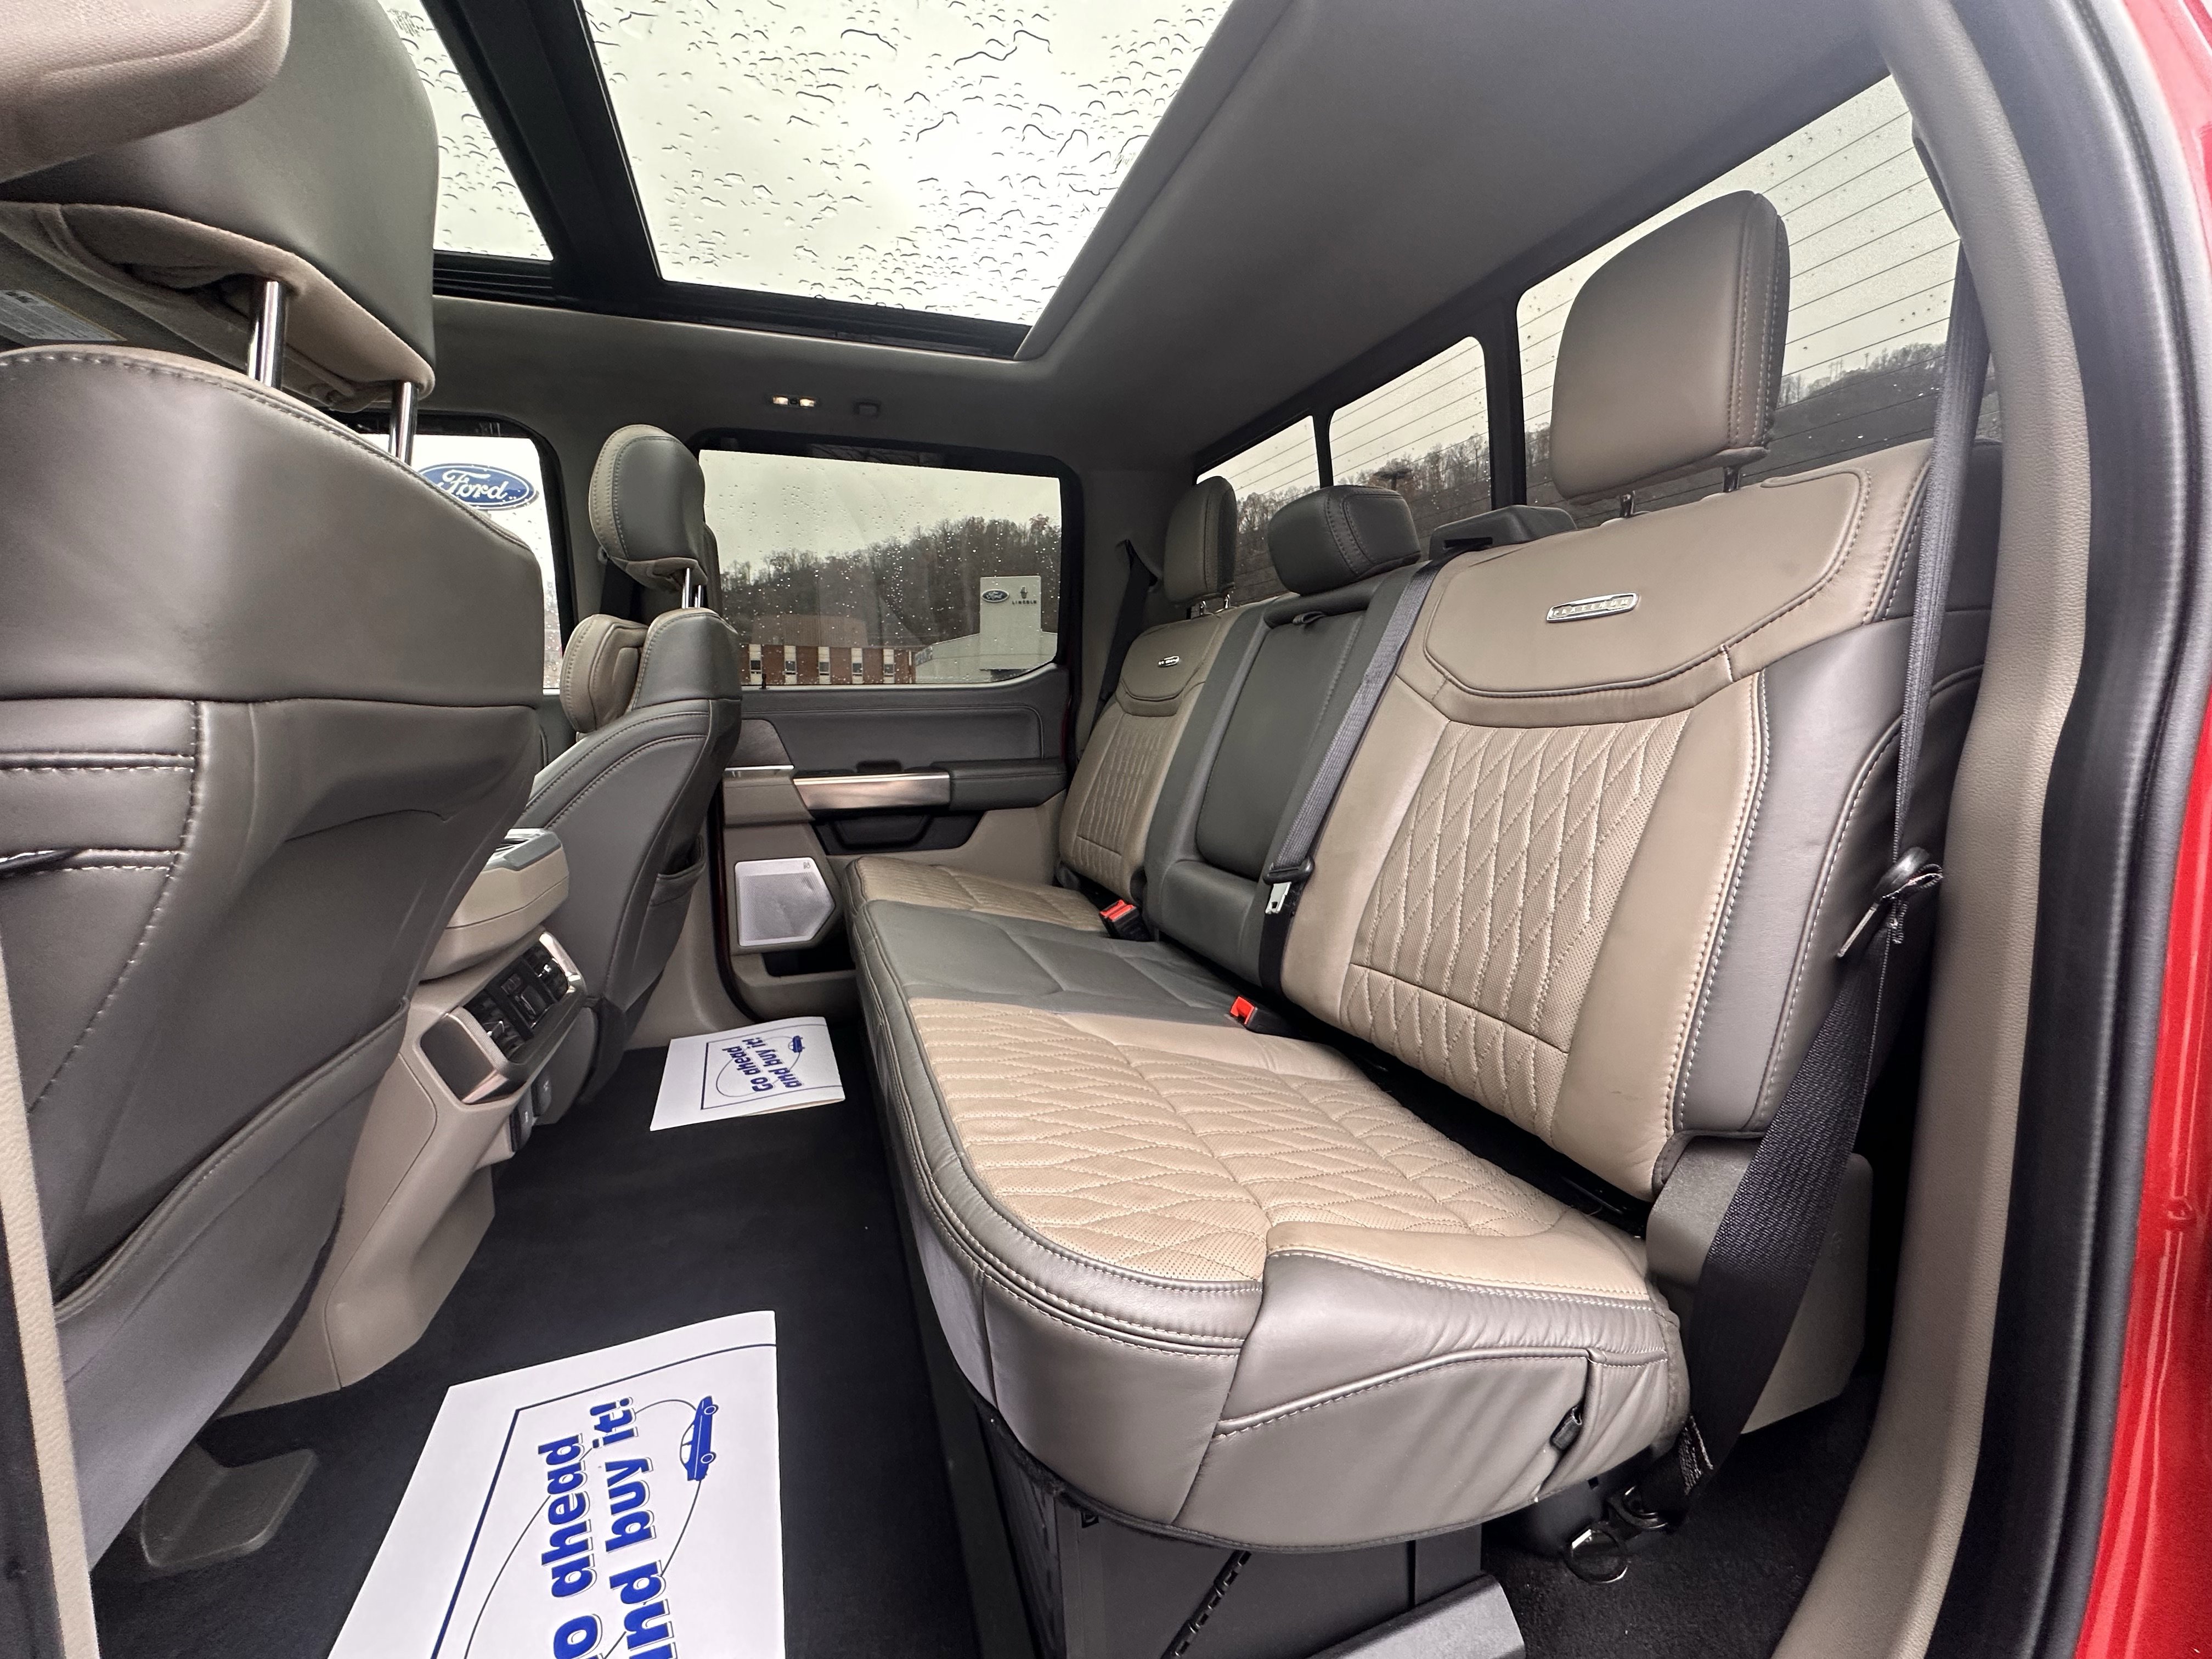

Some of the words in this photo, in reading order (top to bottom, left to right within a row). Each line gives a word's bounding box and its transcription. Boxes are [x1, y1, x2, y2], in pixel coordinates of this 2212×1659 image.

[436, 470, 509, 499] Ford
[1553, 599, 1629, 616] PLATINUM
[741, 1037, 766, 1049] it!
[755, 1048, 783, 1067] buy
[722, 1046, 761, 1075] ahead
[750, 1076, 774, 1092] Go
[768, 1067, 803, 1088] and
[589, 1396, 639, 1449] it!
[538, 1432, 597, 1598] ahead
[605, 1456, 657, 1554] buy
[609, 1559, 678, 1659] nd
[553, 1613, 606, 1659] o
